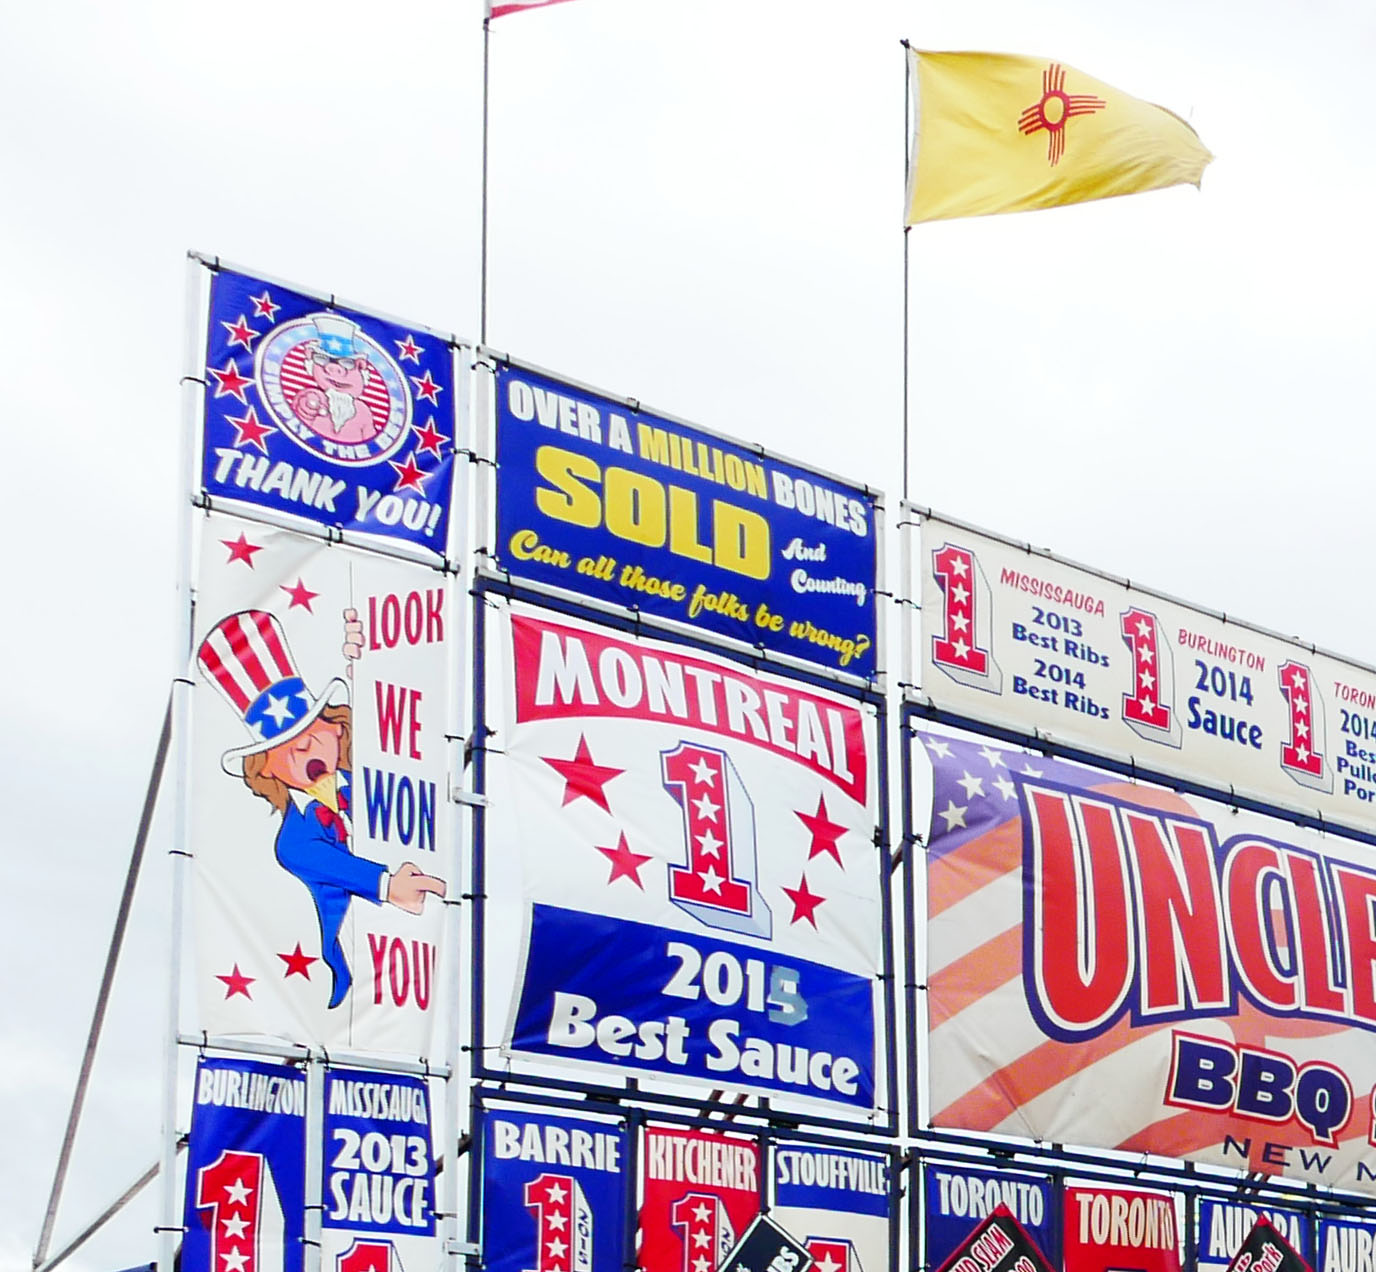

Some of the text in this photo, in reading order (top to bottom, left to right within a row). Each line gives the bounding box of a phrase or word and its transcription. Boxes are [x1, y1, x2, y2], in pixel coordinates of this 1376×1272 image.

[322, 439, 371, 459] THE
[508, 379, 867, 538] OVER A MILLION BONES
[213, 448, 442, 538] THANK YOU!
[535, 444, 771, 581] SOLD
[781, 537, 827, 564] And
[620, 561, 871, 666] those folks wrong?
[791, 567, 867, 607] Counting
[1000, 566, 1106, 619] MISSISSAUGA
[367, 588, 445, 652] LOOK
[1012, 622, 1110, 668] Best Ribs
[1031, 605, 1083, 638] 2013
[1033, 658, 1086, 690] 2014
[1177, 628, 1267, 673] BURLINGTON
[535, 632, 857, 786] MONTREAL
[1012, 675, 1110, 722] Best Ribs
[1194, 659, 1254, 707] 2014
[374, 681, 424, 760] WE
[1187, 696, 1263, 750] Sauce
[363, 767, 437, 852] WON
[548, 990, 861, 1096] Best Sauce
[198, 1067, 307, 1119] BURLINGTON
[1167, 1030, 1355, 1150] BBQ
[329, 1128, 430, 1178] 2013
[493, 1120, 622, 1174] BARRIE
[647, 1133, 759, 1193] KITCHENER
[776, 1149, 888, 1196] STOUFFVILLE
[1222, 1135, 1335, 1176] NEW
[328, 1171, 430, 1230] SAUCE
[936, 1172, 1045, 1227] TORONTO
[1075, 1191, 1176, 1250] TORONTO
